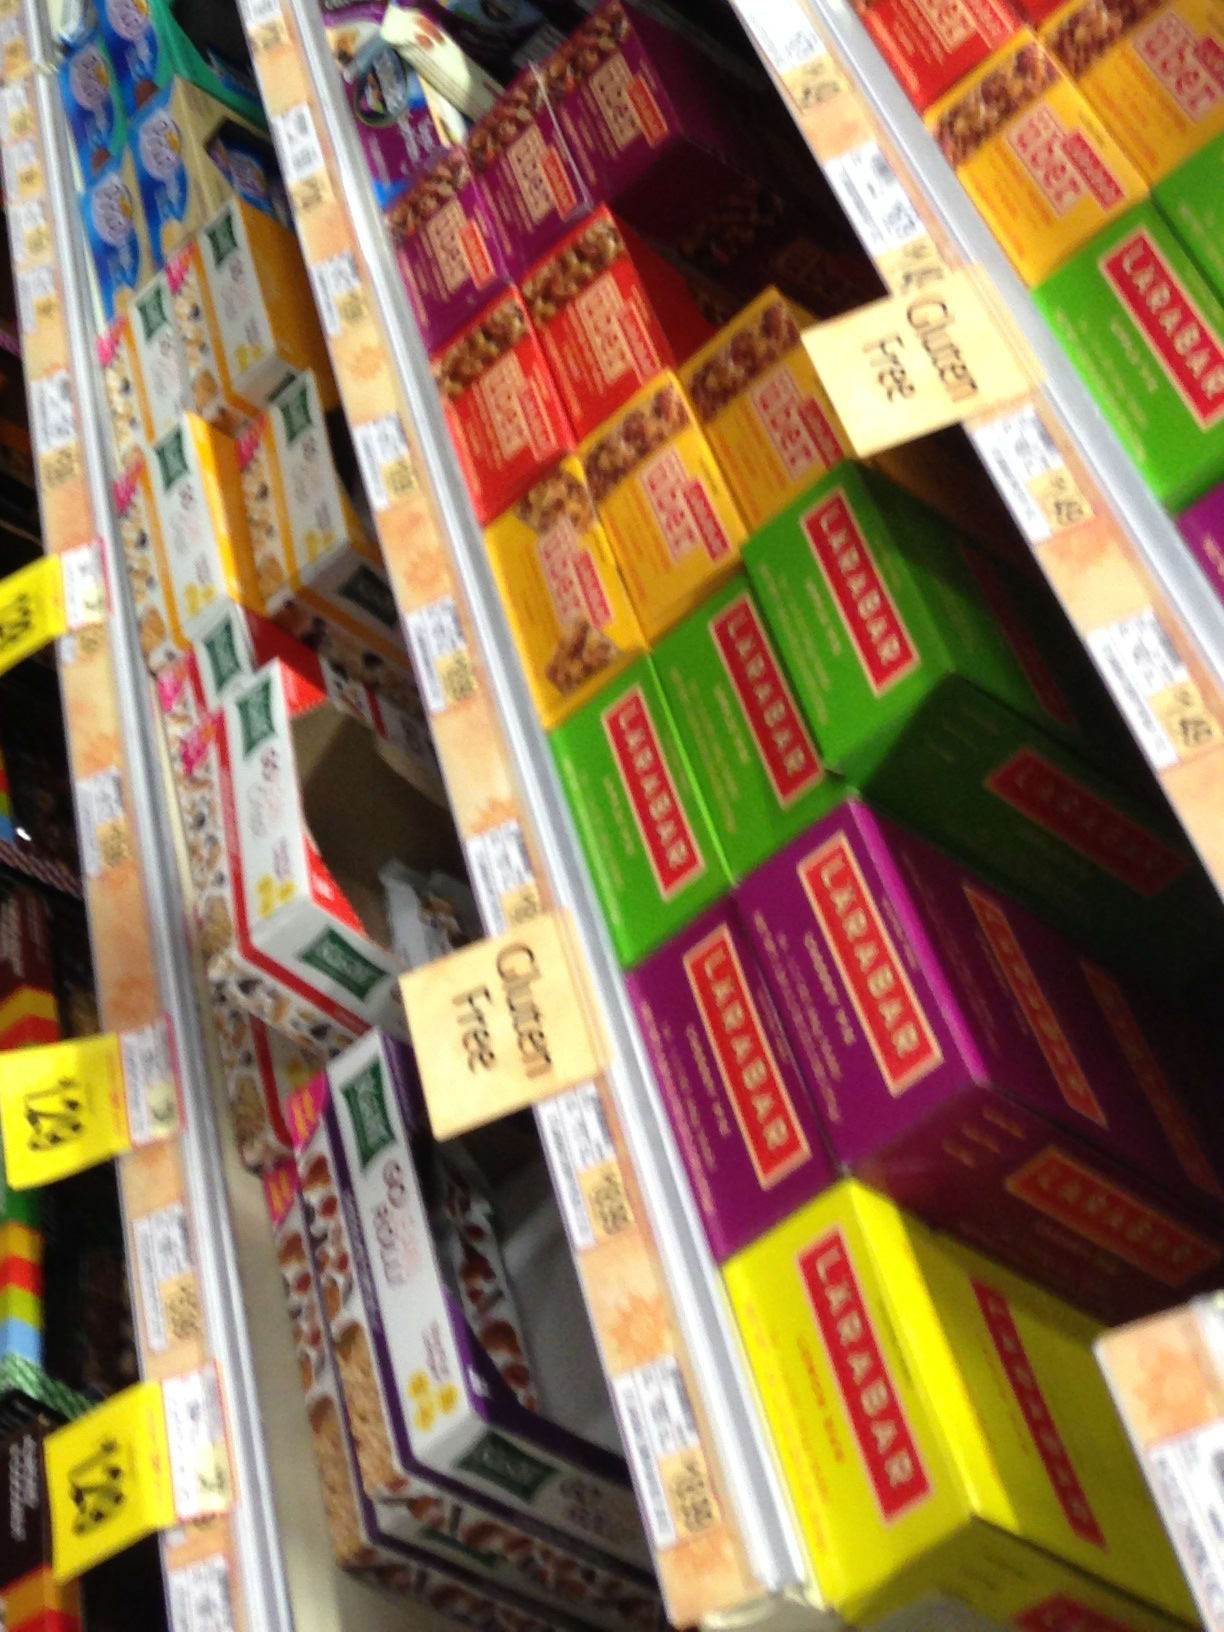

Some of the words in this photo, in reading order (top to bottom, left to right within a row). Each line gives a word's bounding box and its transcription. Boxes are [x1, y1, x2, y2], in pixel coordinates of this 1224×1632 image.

[863, 335, 916, 404] Free
[905, 294, 979, 400] Gluten
[1118, 243, 1222, 399] LARABAR
[819, 505, 901, 665] LARABAR
[726, 608, 807, 775] LARABAR
[618, 708, 689, 874] LARABAR
[451, 985, 495, 1074] Free
[495, 942, 553, 1080] Gluten
[818, 853, 921, 1059] LARABAR
[702, 948, 792, 1150] LARABAR
[812, 1245, 916, 1487] LARABAR
